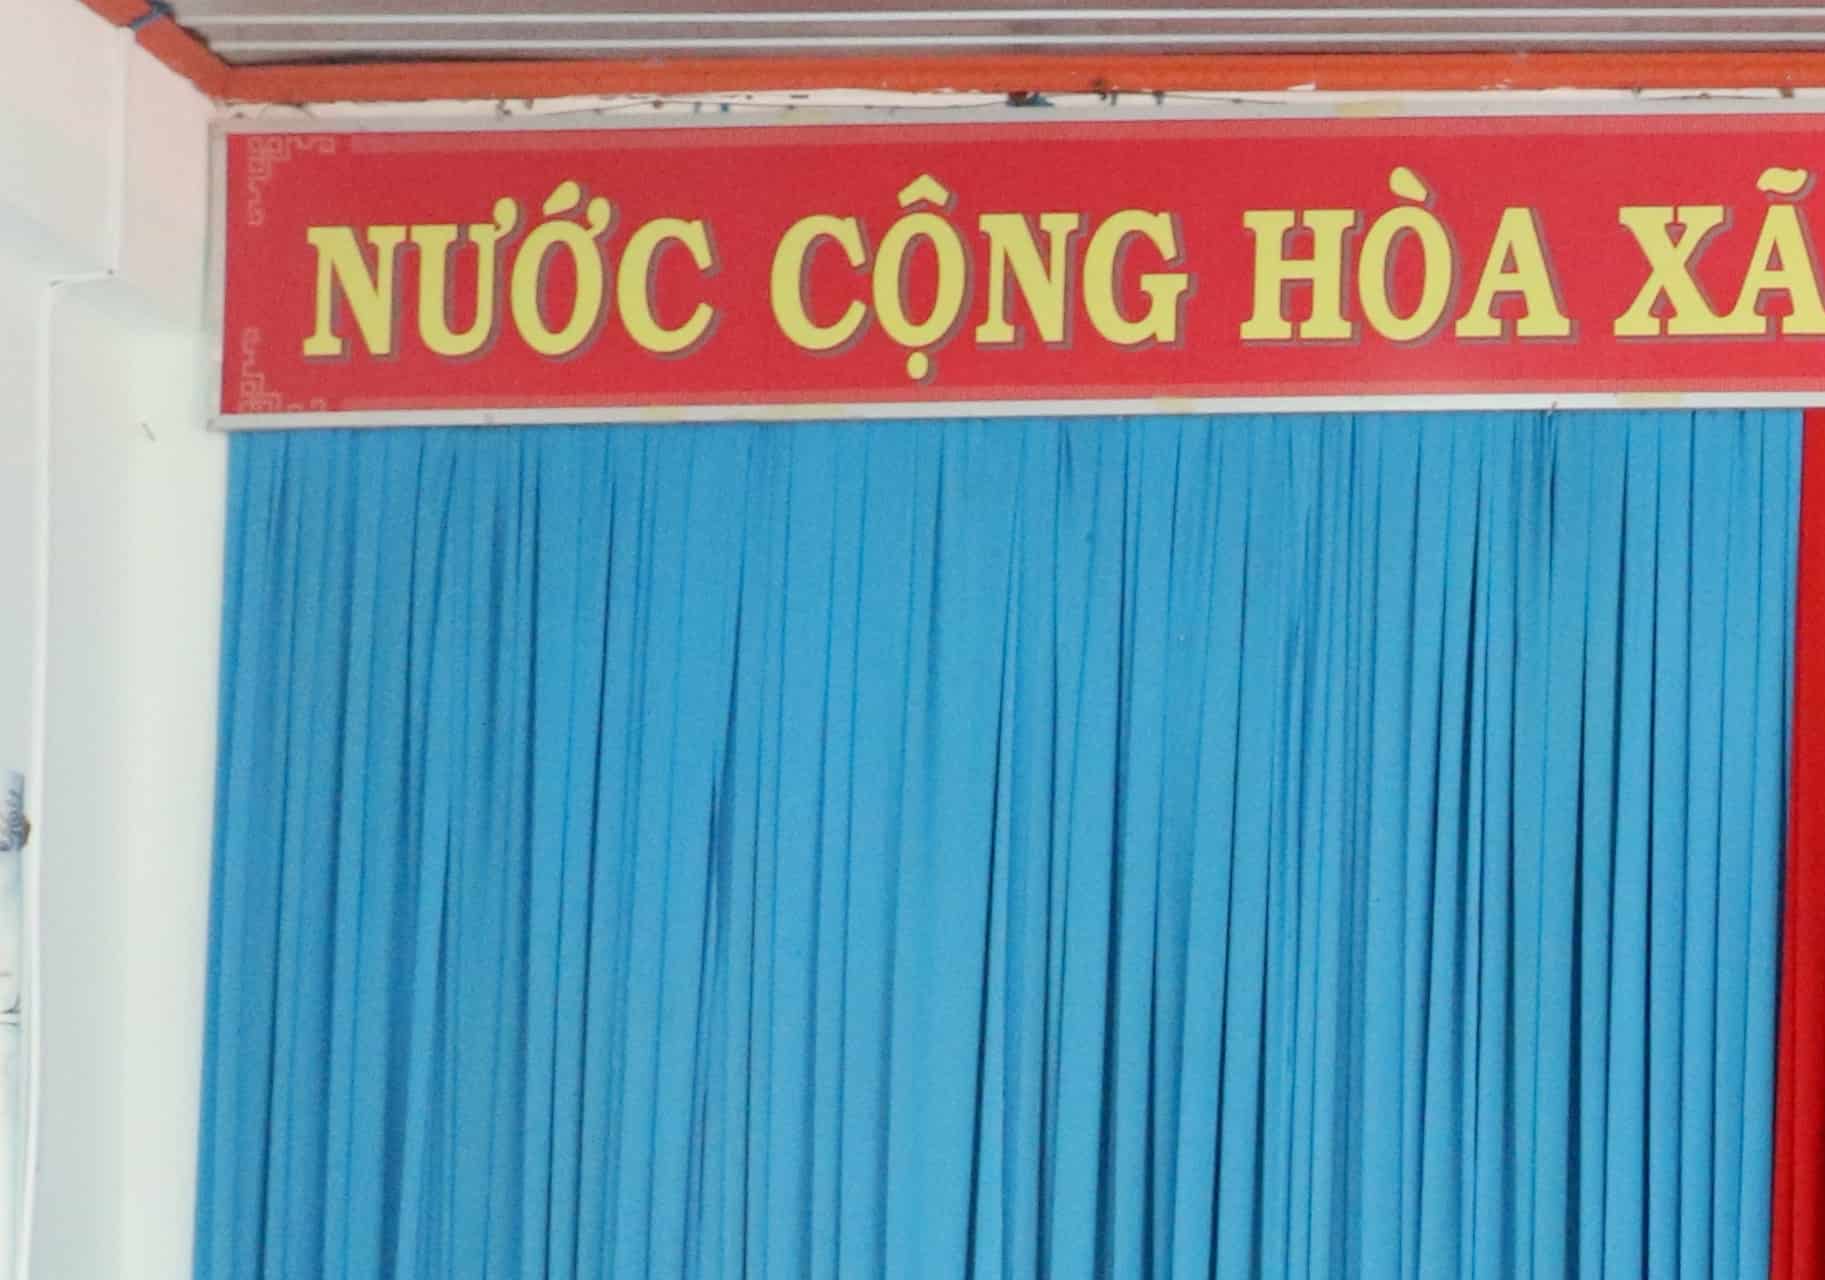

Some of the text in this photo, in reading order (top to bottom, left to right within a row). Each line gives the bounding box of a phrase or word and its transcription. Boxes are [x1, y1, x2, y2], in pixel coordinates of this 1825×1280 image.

[302, 180, 714, 357] NƯỚC
[770, 173, 1189, 380] CỘNG
[1239, 166, 1571, 342] HÒA
